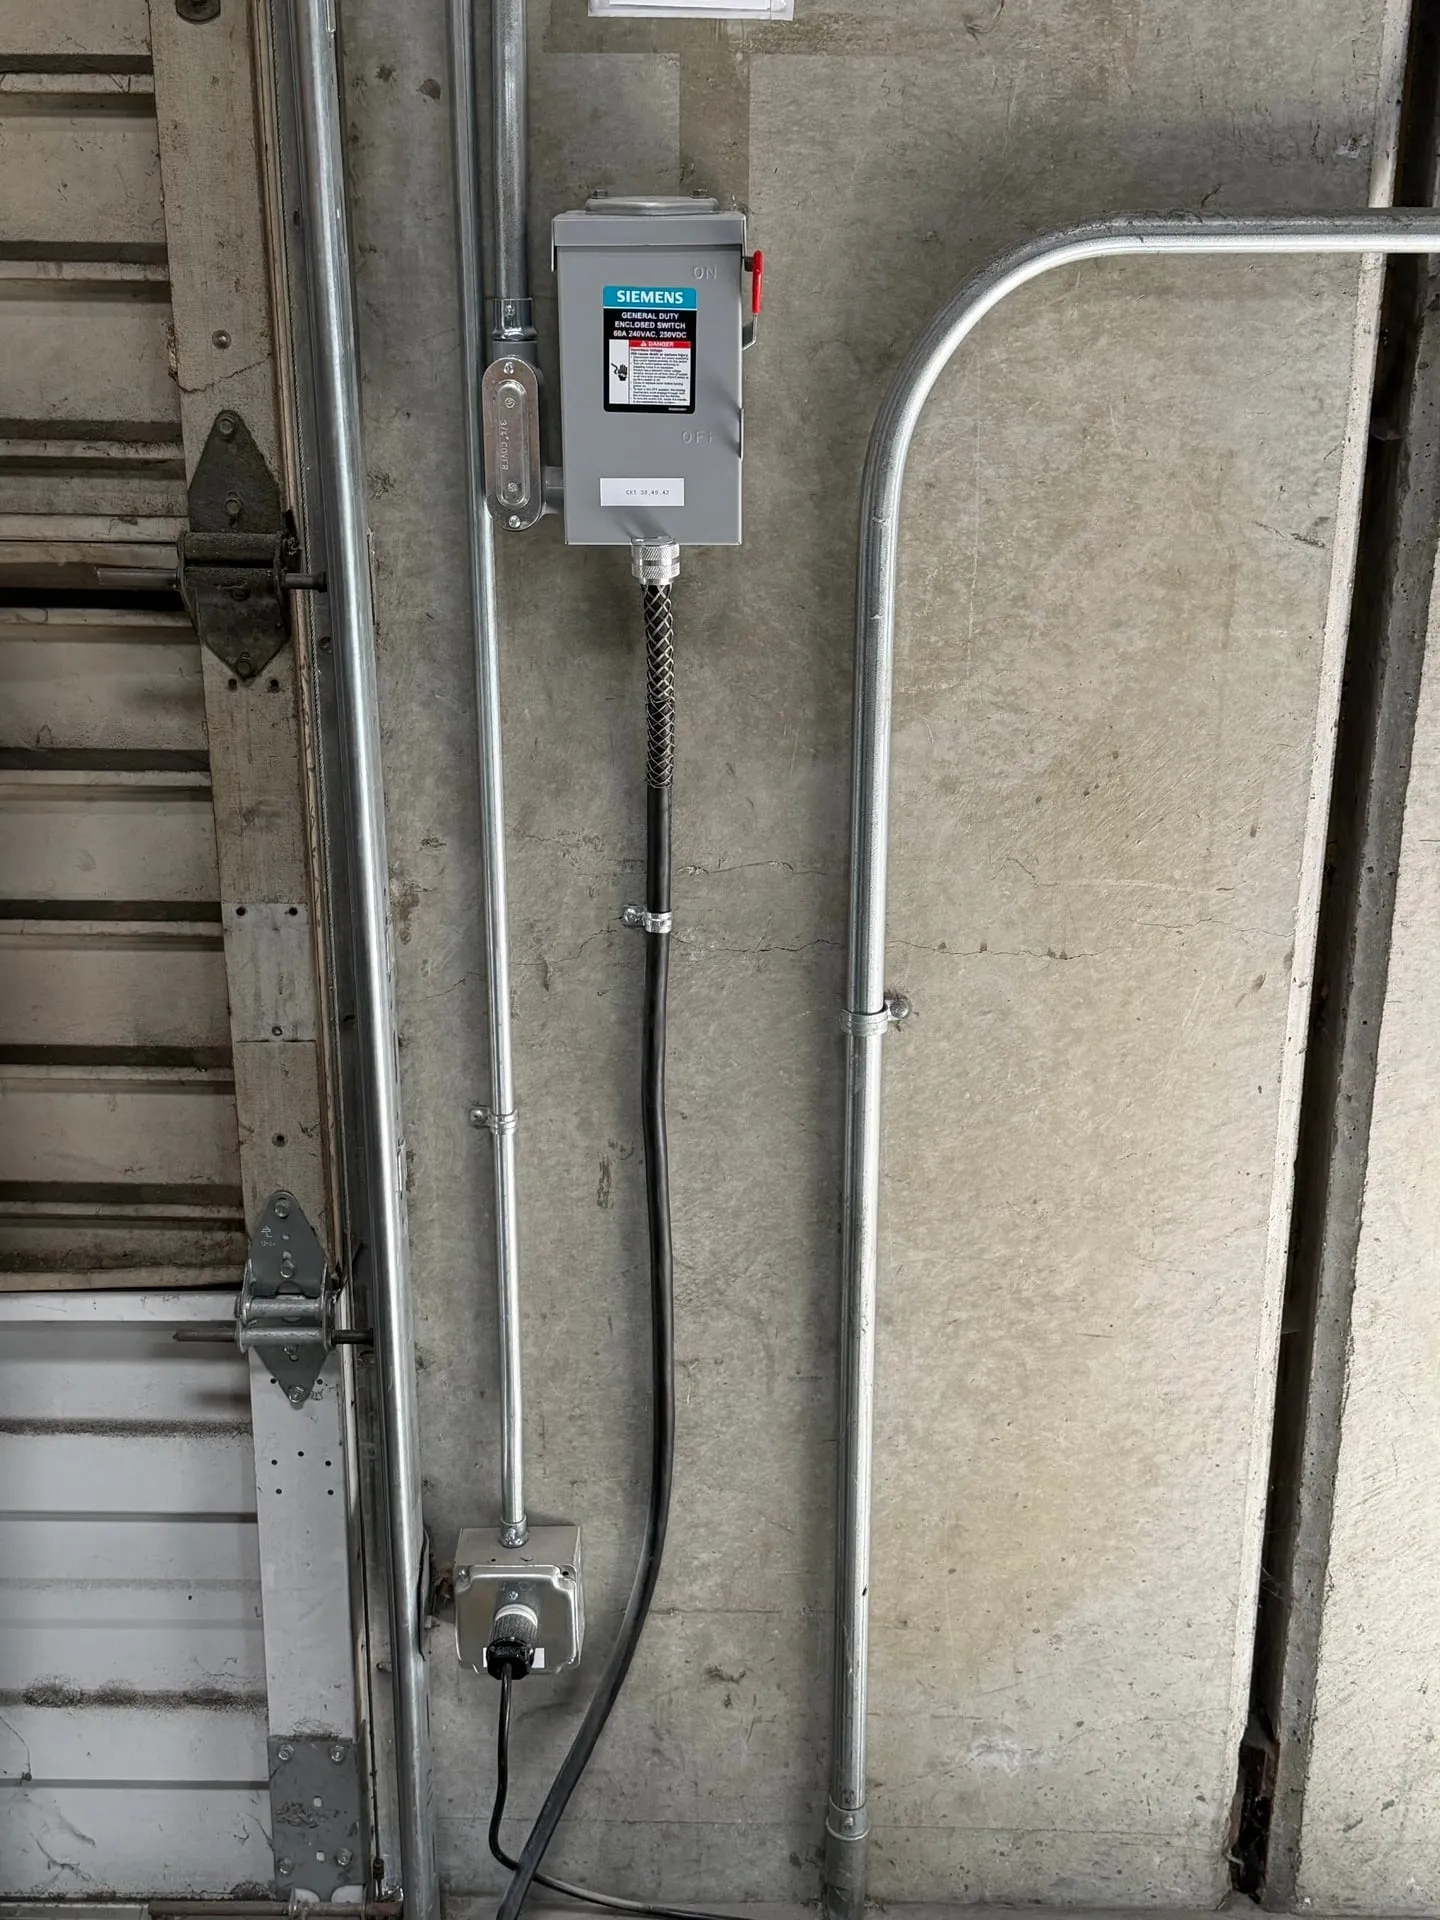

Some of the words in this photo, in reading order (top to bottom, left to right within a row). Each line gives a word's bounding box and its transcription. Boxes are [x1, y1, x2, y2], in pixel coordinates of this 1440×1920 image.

[693, 265, 717, 280] ON
[616, 290, 684, 304] SIEMENS
[621, 312, 657, 320] GENERAL
[614, 321, 655, 329] ENCLOSED
[657, 322, 686, 330] SWITCH
